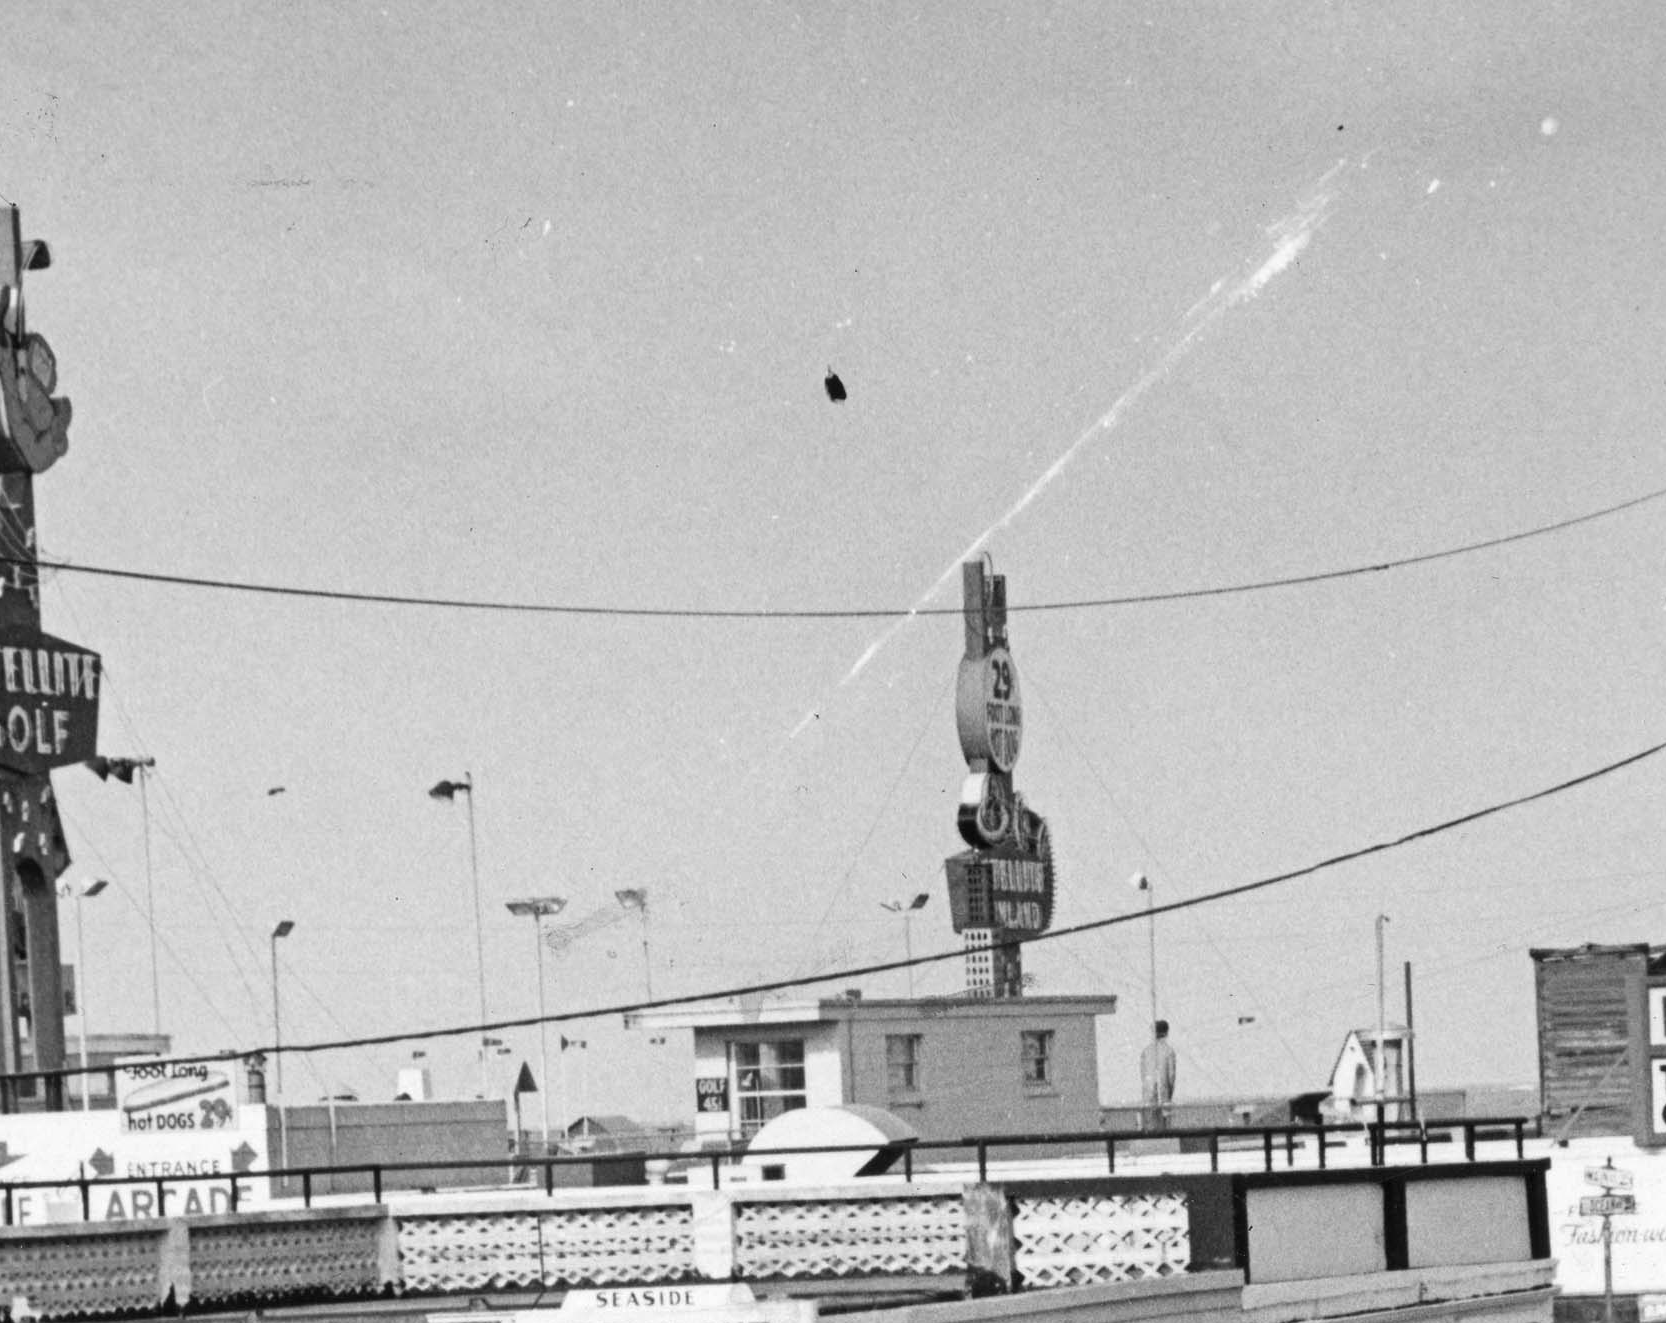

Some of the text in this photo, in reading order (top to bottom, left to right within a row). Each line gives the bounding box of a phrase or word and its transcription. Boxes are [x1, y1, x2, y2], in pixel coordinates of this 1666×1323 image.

[992, 659, 1011, 701] 29
[698, 1079, 725, 1095] GOLF
[128, 1112, 153, 1131] hot
[157, 1112, 195, 1130] DOGS
[127, 1160, 222, 1178] ENTRANCE
[596, 1290, 694, 1307] SEASIDE
